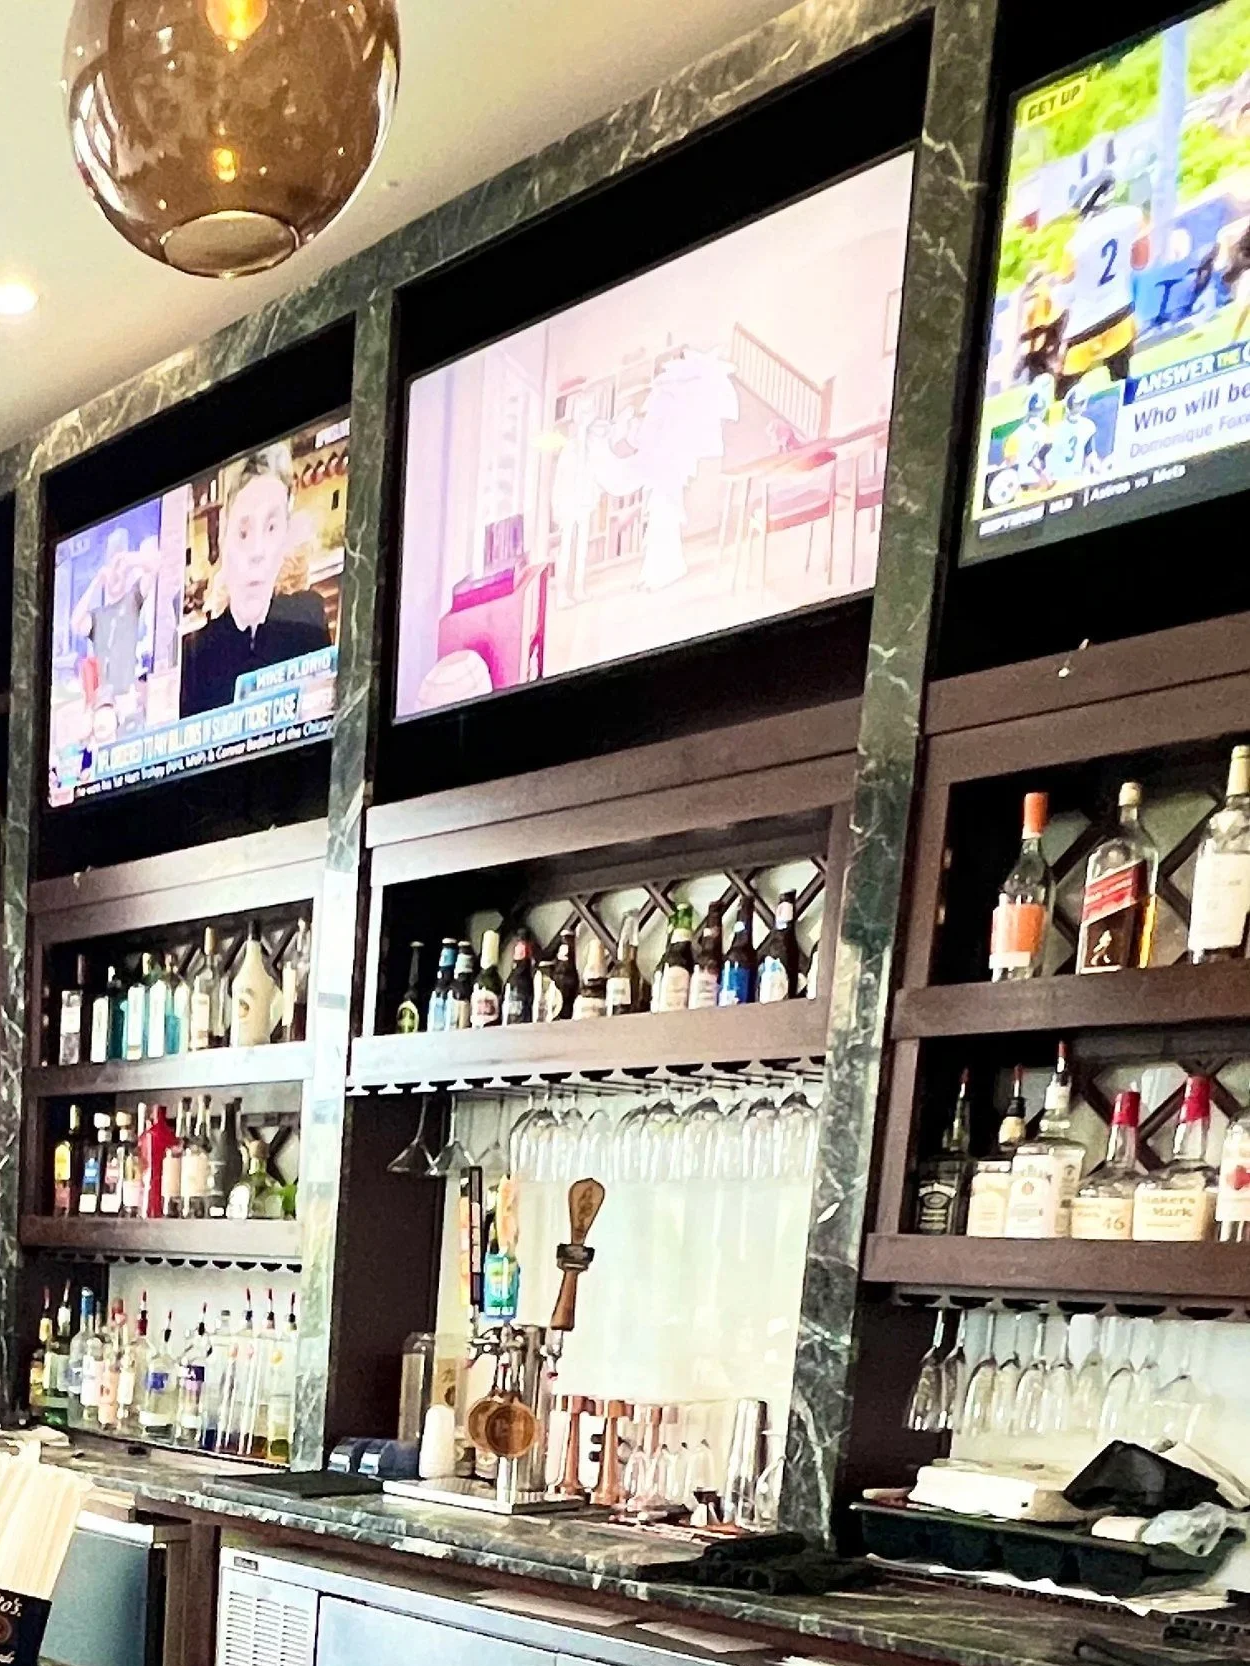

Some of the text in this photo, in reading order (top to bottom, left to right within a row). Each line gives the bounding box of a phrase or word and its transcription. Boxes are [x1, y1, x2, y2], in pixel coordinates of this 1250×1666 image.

[1027, 84, 1081, 121] GET UP
[1097, 238, 1119, 287] 2
[1135, 353, 1216, 397] ANSWER
[1134, 406, 1177, 433] Who
[1185, 386, 1221, 417] will
